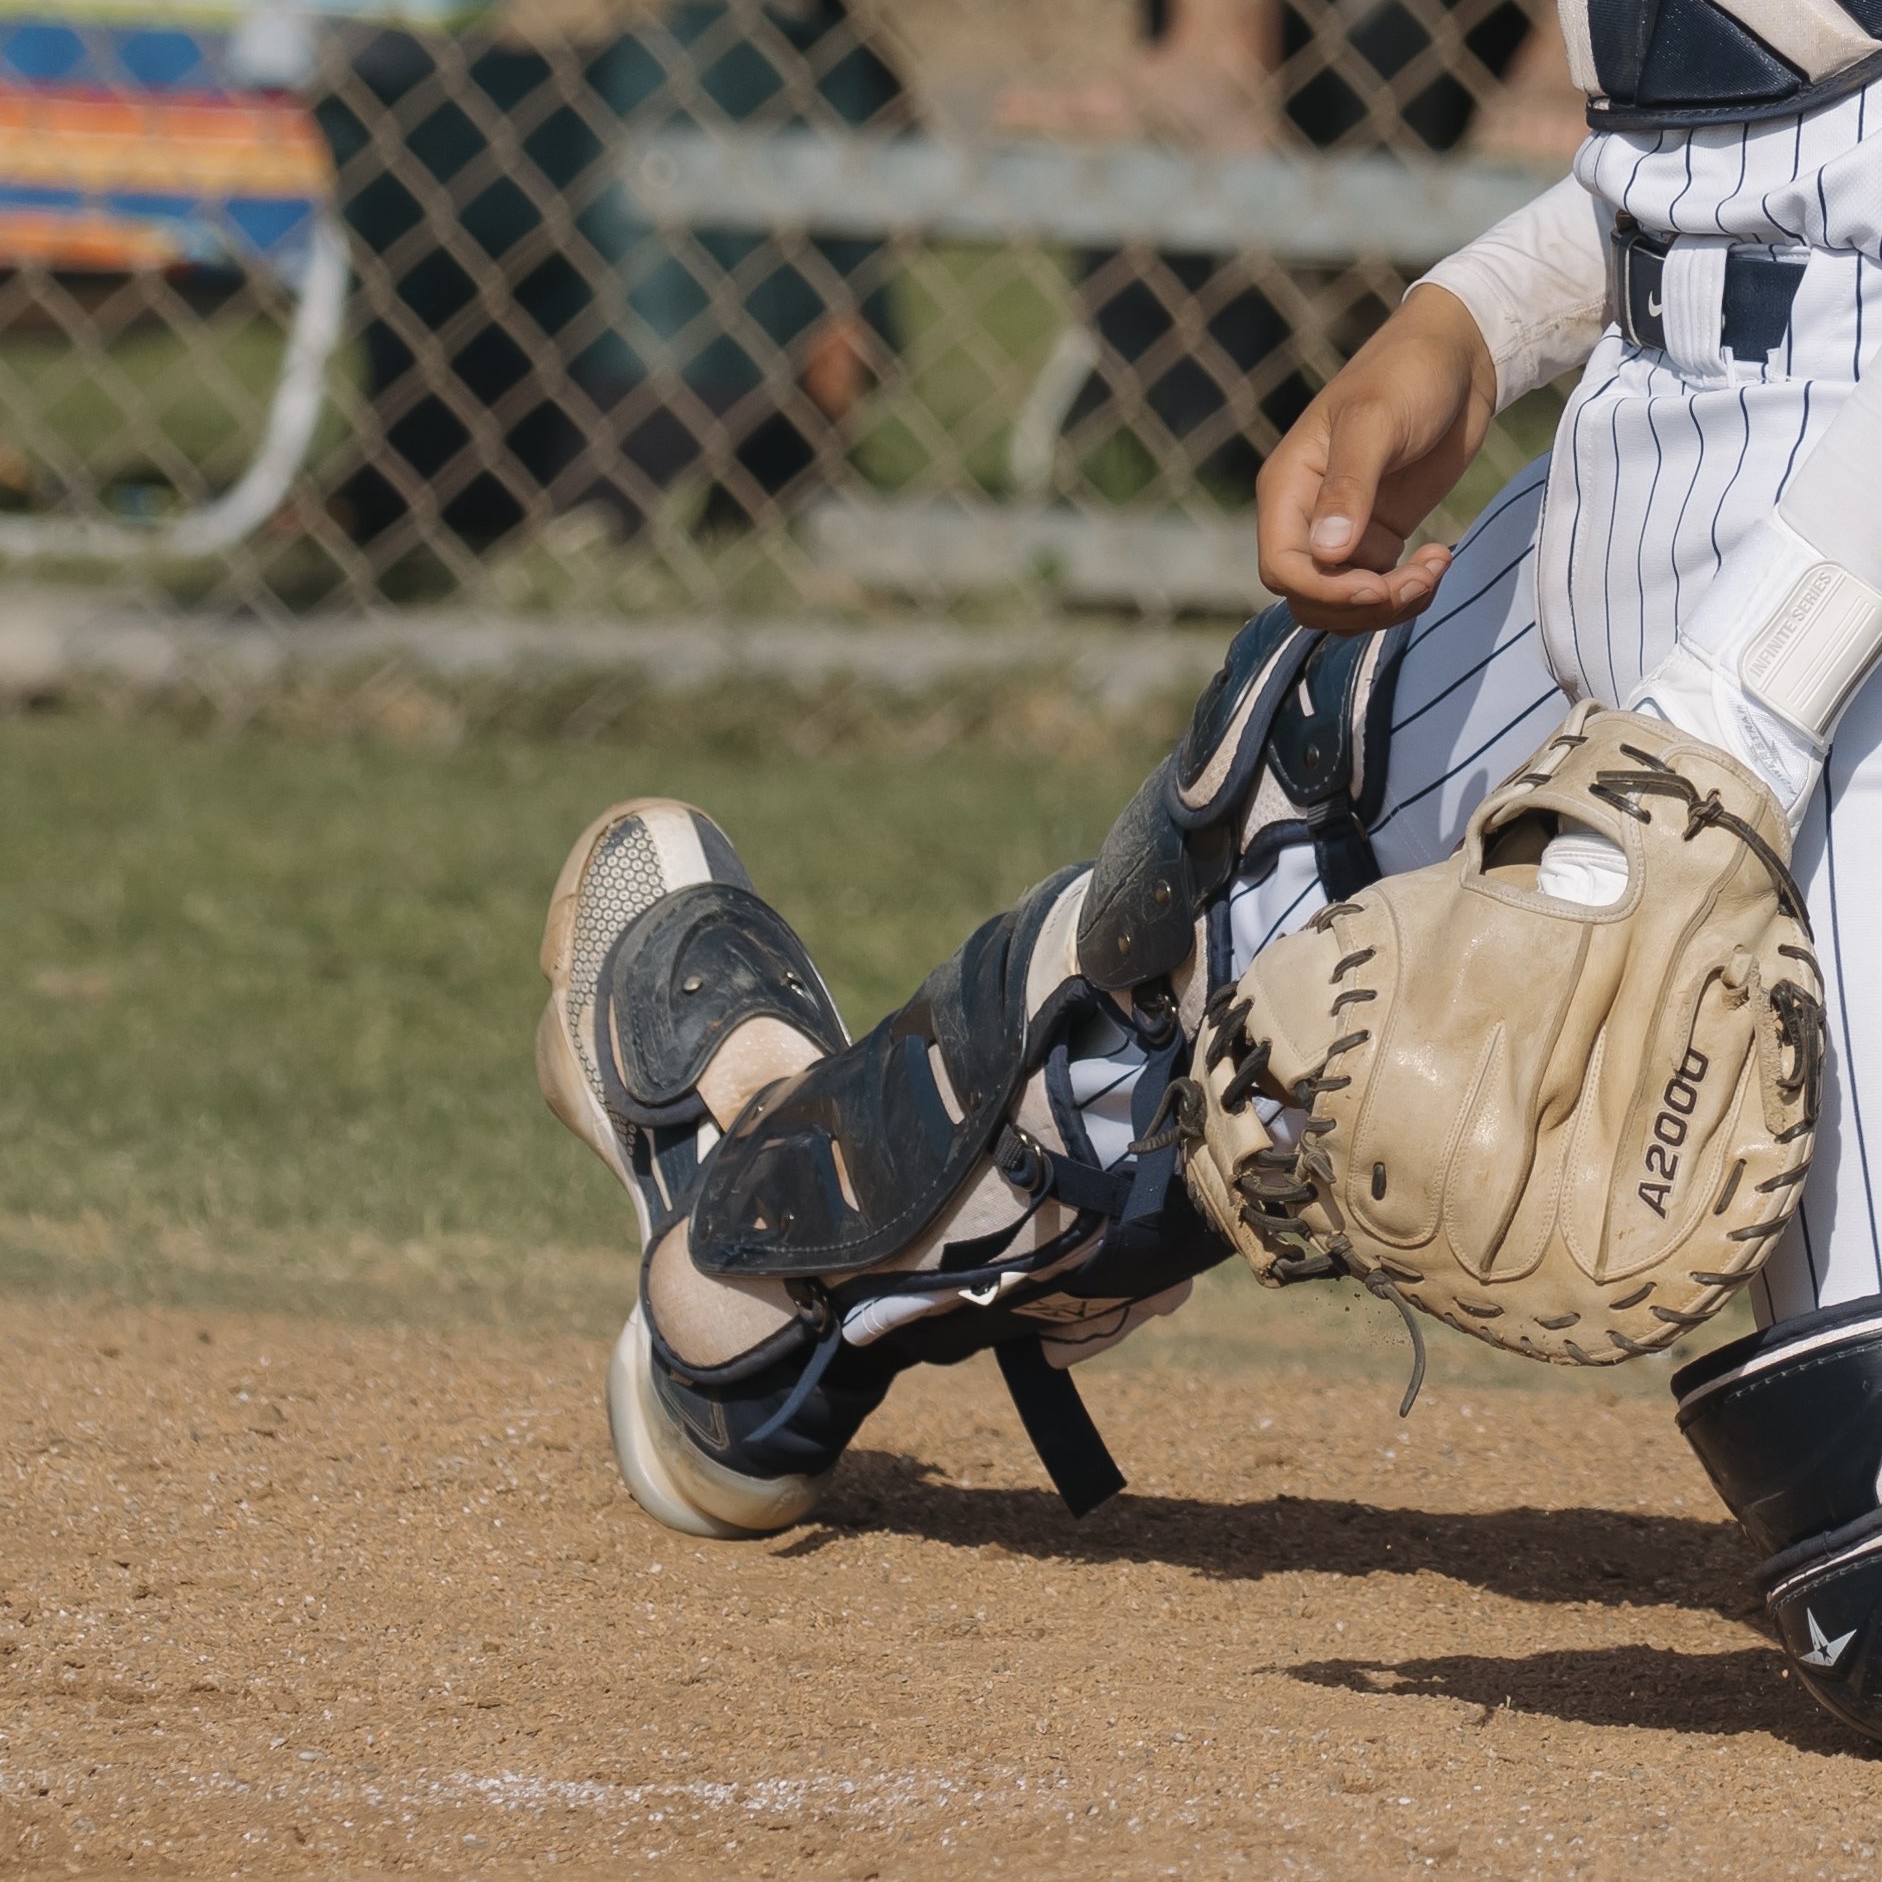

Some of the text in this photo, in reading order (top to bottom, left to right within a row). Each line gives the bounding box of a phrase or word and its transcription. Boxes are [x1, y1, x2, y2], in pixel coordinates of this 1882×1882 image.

[1749, 571, 1831, 678] INFINITE SERIES
[1638, 1047, 1709, 1219] A2000
